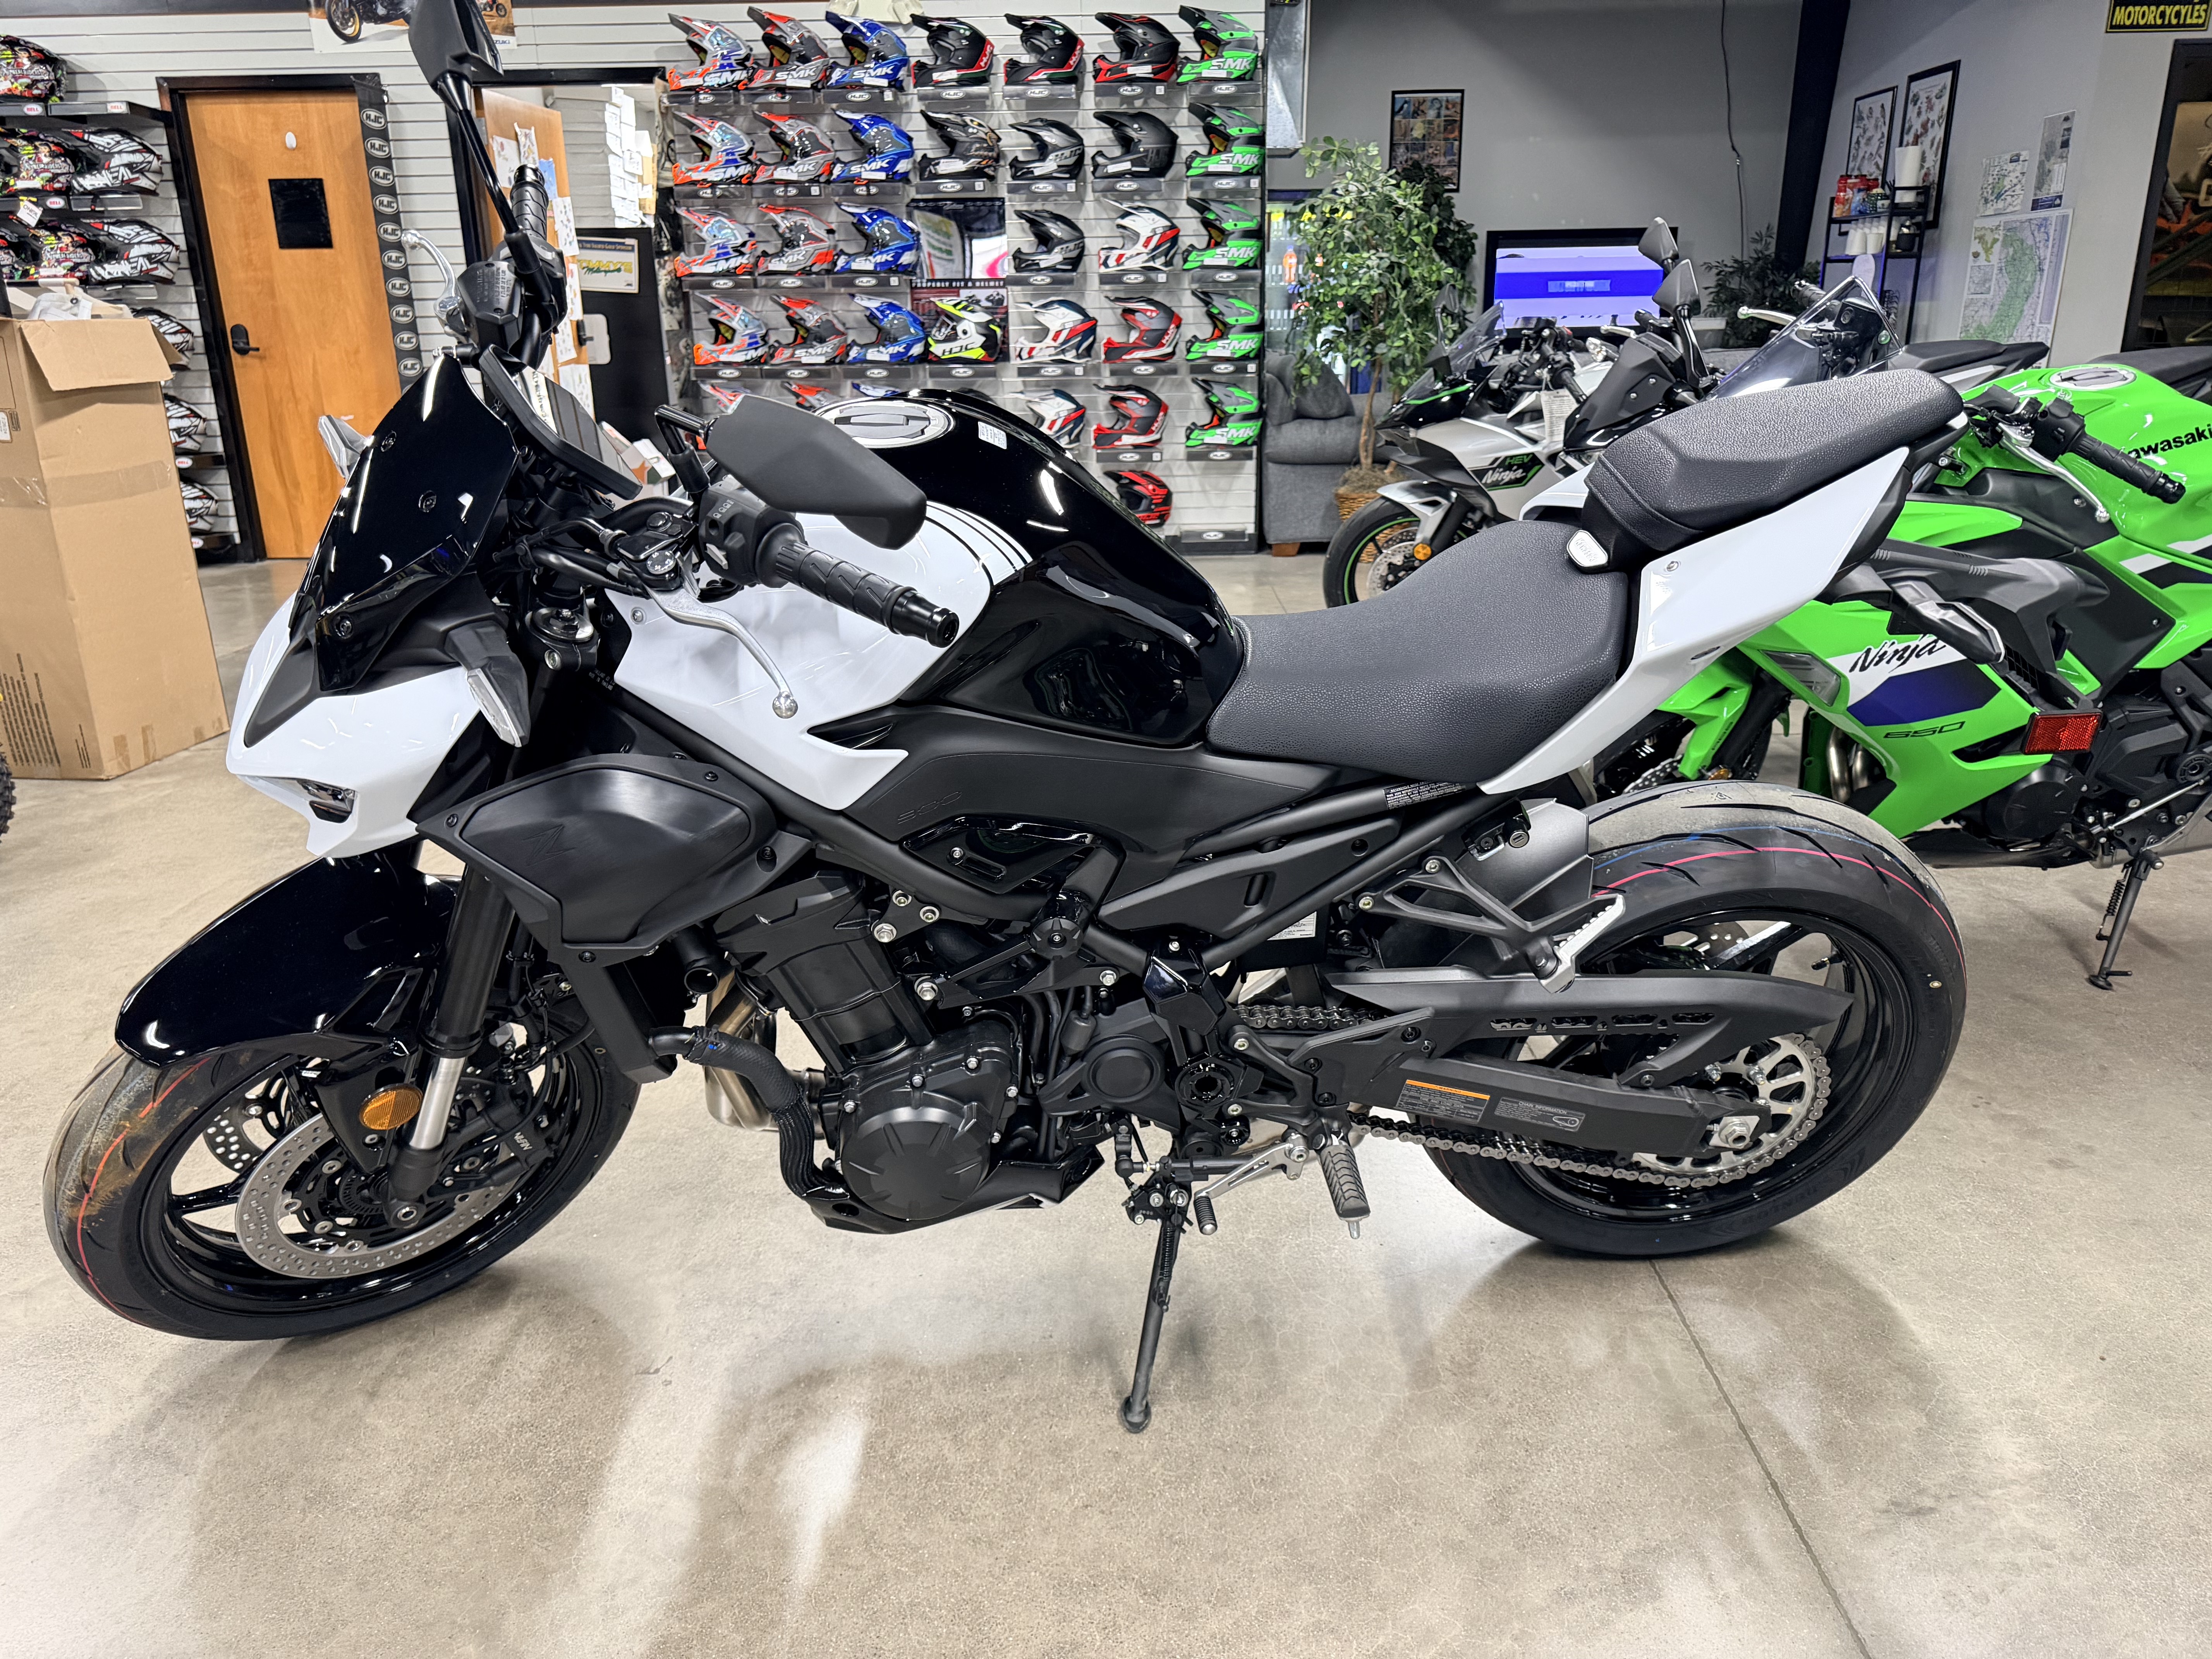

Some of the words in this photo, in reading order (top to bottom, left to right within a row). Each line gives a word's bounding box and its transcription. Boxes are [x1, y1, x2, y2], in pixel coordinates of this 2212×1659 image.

[2112, 4, 2208, 26] MOTORCYCLES
[1211, 58, 1252, 70] SMK
[775, 68, 817, 80] SMK
[853, 65, 894, 77] SMK
[365, 113, 383, 124] HJC
[370, 141, 386, 153] HJC
[1219, 153, 1259, 165] SMK
[775, 162, 816, 175] SMK
[850, 159, 892, 174] SMK
[374, 170, 390, 181] HJC
[378, 199, 395, 209] HJC
[383, 228, 399, 237] HJC
[771, 251, 805, 264] SMK
[855, 252, 894, 264] SMK
[1215, 246, 1256, 258] SMK
[387, 255, 403, 264] HJC
[391, 282, 407, 291] HJC
[395, 309, 410, 318] HJC
[399, 336, 414, 345] HJC
[1217, 338, 1258, 350] SMK
[795, 345, 835, 358] SMK
[866, 344, 906, 356] SMK
[941, 342, 977, 356] HJC
[403, 362, 418, 371] HJC
[1215, 427, 1257, 438] SMK
[2128, 424, 2212, 459] awasaki
[1505, 453, 1534, 465] HEV
[1481, 465, 1527, 485] Ninja
[1849, 633, 1947, 673] Ninja
[1883, 721, 1966, 739] 650
[1439, 1085, 1462, 1094] WARNING
[1535, 1104, 1568, 1115] INFORMATION
